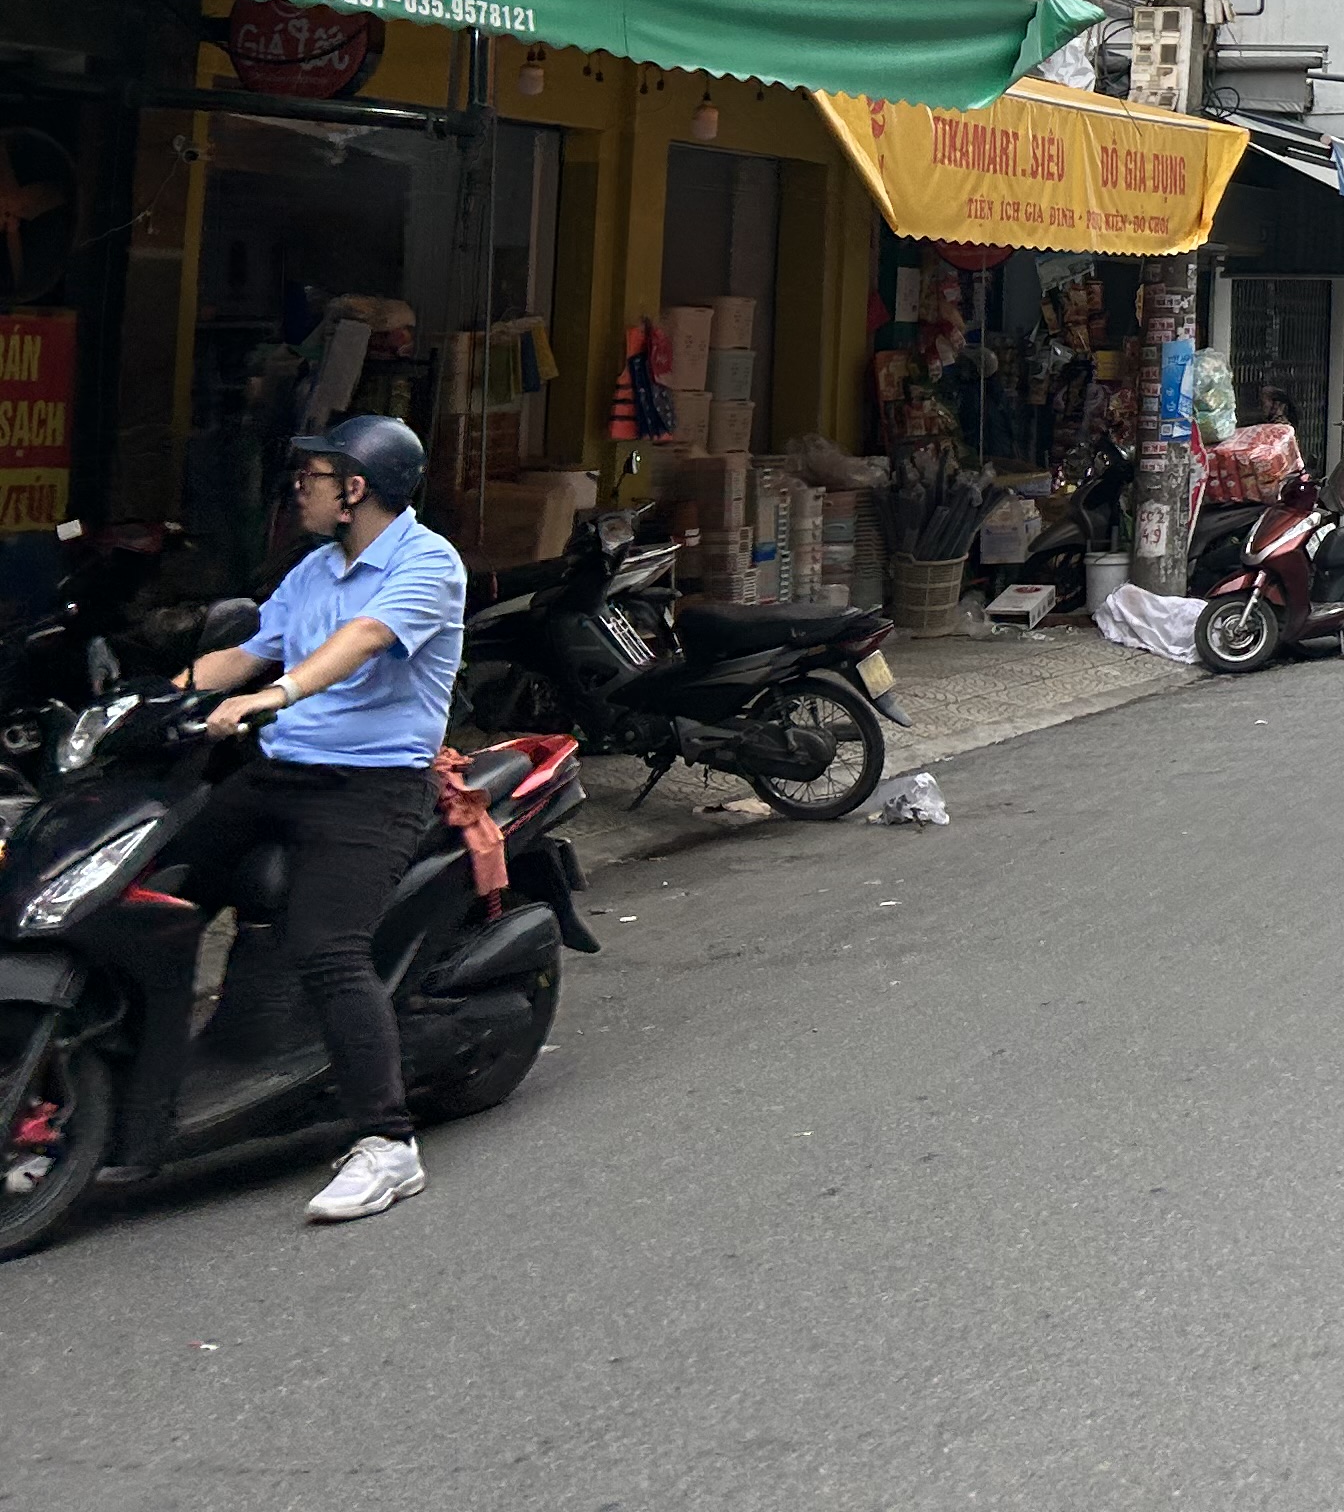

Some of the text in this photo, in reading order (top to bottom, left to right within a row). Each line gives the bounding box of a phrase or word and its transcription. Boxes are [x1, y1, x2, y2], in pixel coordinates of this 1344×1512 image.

[1124, 149, 1147, 193] GIA
[1152, 152, 1187, 204] DỤNG
[966, 193, 994, 228] TIỆN
[1024, 201, 1044, 224] GIA
